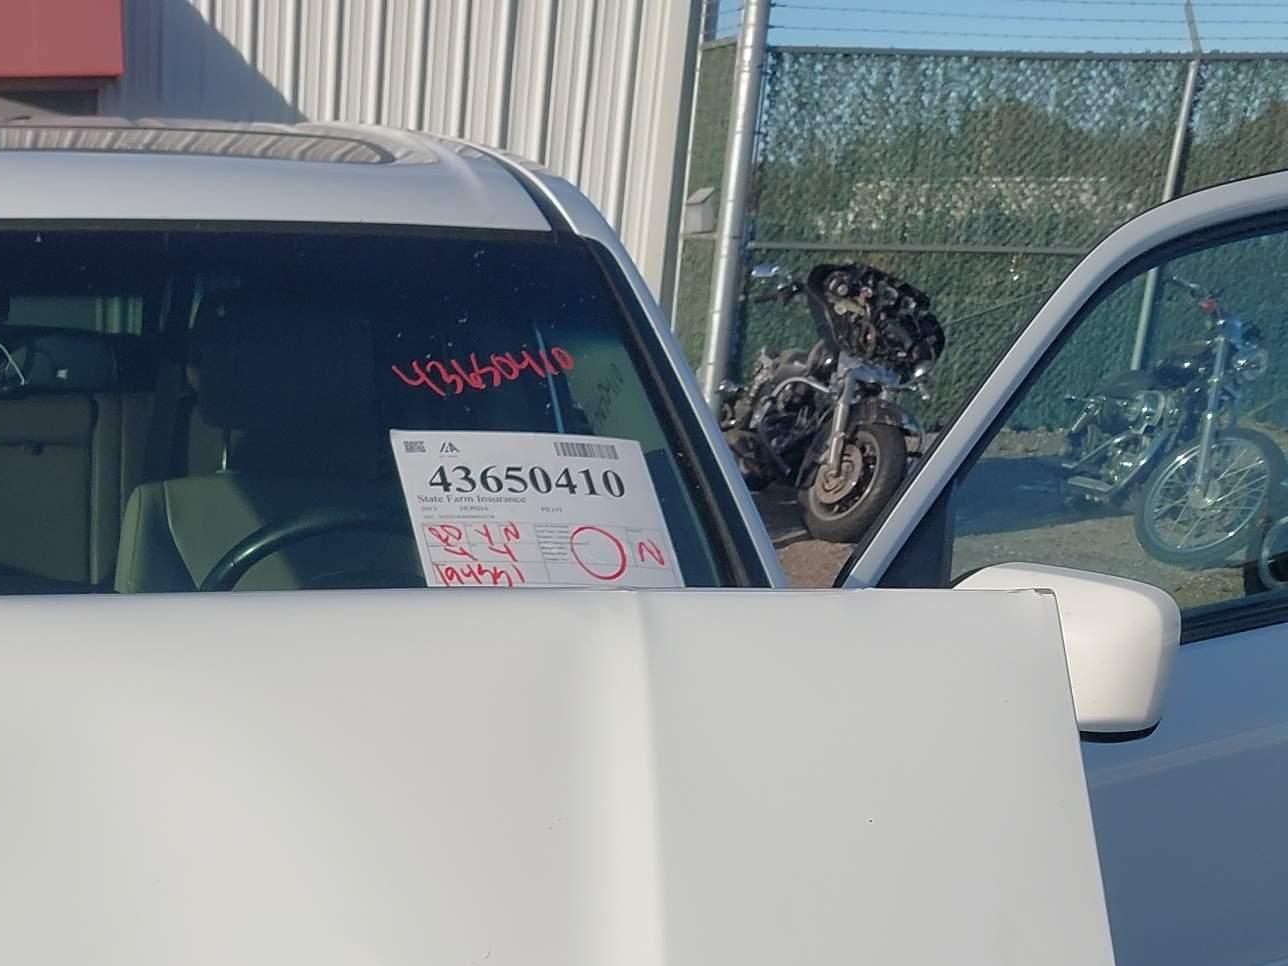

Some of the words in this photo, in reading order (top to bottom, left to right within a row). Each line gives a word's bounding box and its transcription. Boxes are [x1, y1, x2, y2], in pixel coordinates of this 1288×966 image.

[391, 347, 575, 397] 43650410
[428, 465, 626, 498] 43650410
[417, 494, 444, 503] State
[447, 494, 474, 503] Farm
[477, 494, 527, 504] Insurance
